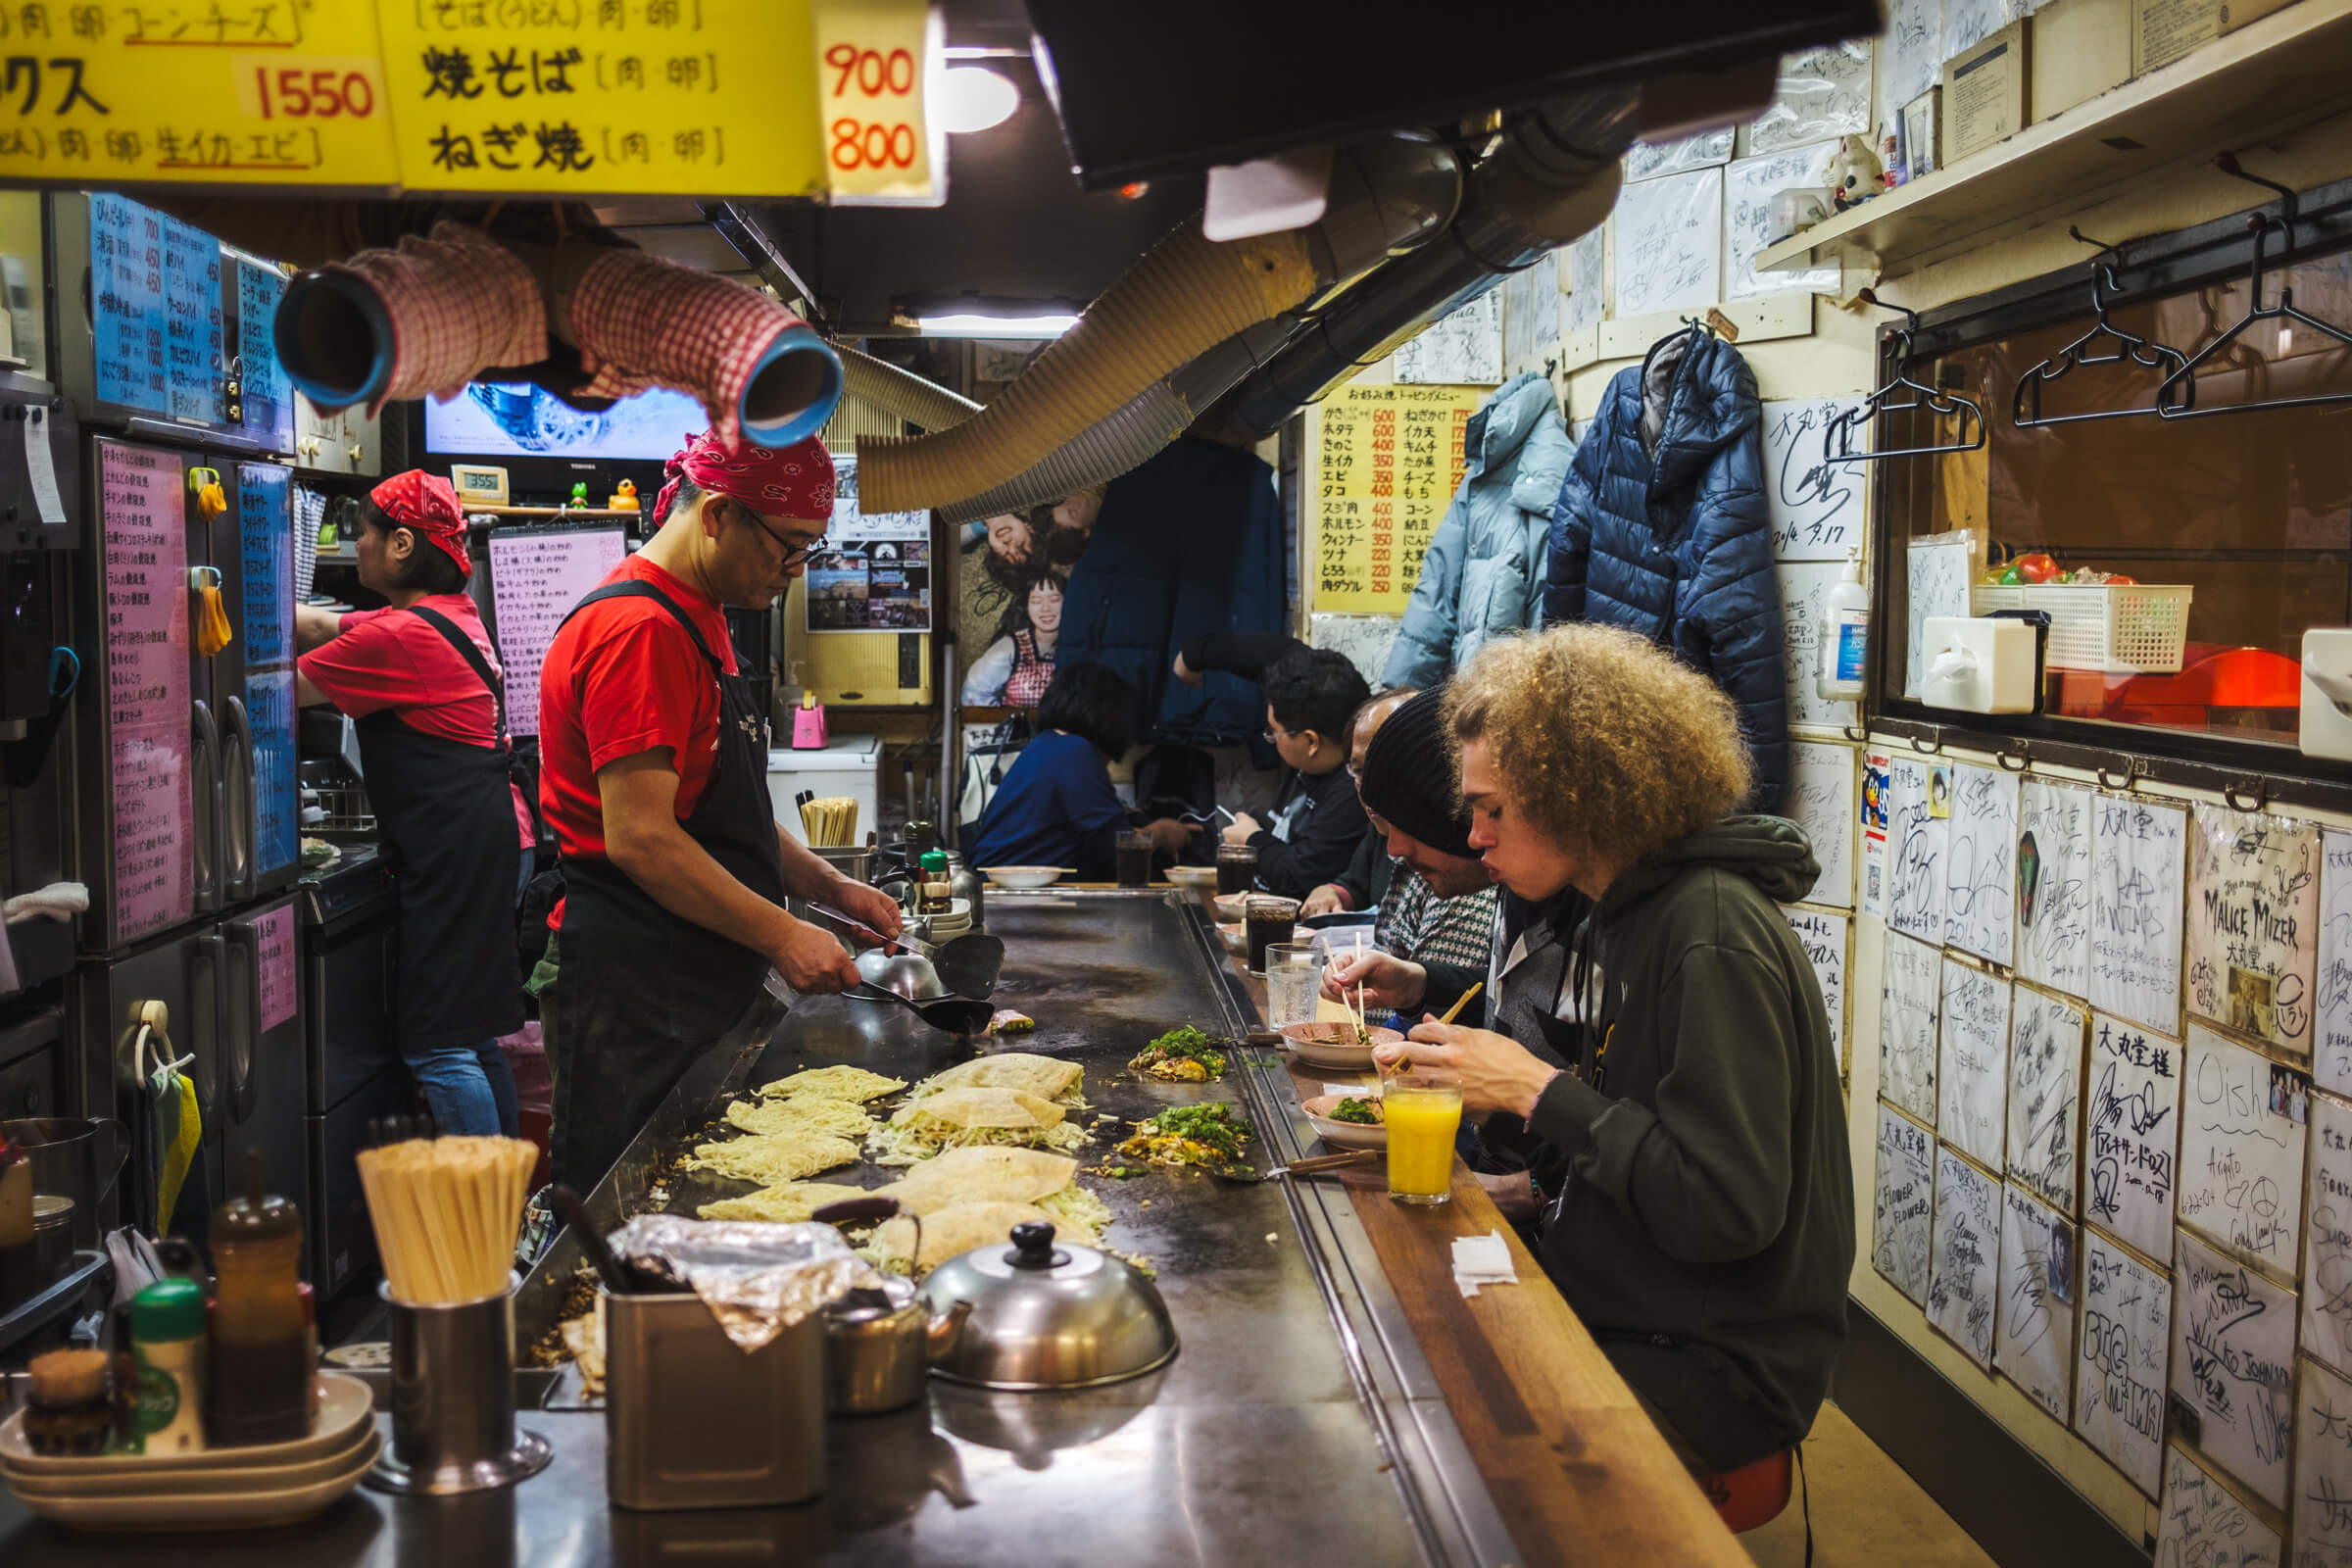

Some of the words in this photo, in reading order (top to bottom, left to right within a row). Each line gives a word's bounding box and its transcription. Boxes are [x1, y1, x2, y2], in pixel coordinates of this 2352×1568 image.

[422, 45, 583, 99] 焼そば
[825, 43, 914, 98] 900
[0, 56, 110, 116] クス
[257, 67, 373, 120] 1550
[429, 122, 595, 172] ねぎ焼
[830, 118, 915, 172] 800
[1348, 389, 1396, 400] お好み焼
[1399, 391, 1460, 401] トッピングメニュー
[1324, 408, 1343, 419] かき
[1373, 409, 1396, 422] 600
[1403, 409, 1446, 421] ねぎかけ
[1324, 422, 1354, 435] ホタテ
[1373, 424, 1396, 437] 600
[1403, 424, 1436, 438] イカ天
[1451, 426, 1466, 439] 17
[1324, 438, 1353, 451] きのこ
[1372, 439, 1395, 452] 400
[1403, 440, 1438, 453] キムチ
[1451, 442, 1465, 455] 17
[1323, 455, 1353, 467] 生イカ
[1372, 454, 1394, 467] 350
[1451, 457, 1465, 470] 17
[1323, 470, 1348, 482] エビ
[1372, 470, 1394, 483] 350
[1403, 471, 1435, 484] チーズ
[1450, 472, 1465, 485] 22
[1323, 485, 1346, 498] タコ
[1370, 484, 1394, 498] 400
[1403, 486, 1429, 499] もち
[1322, 501, 1358, 514] スジ肉
[1372, 503, 1393, 514] 400
[1405, 504, 1434, 514] コーン
[1322, 516, 1364, 530] ホルモン
[1372, 517, 1393, 530] 400
[1404, 518, 1429, 530] 納豆
[1372, 533, 1393, 546] 350
[1322, 549, 1348, 562] ツナ
[1372, 549, 1391, 561] 220
[1321, 564, 1346, 576] とろろ
[1372, 564, 1391, 577] 220
[1321, 579, 1363, 593] 肉ダブル
[1372, 580, 1390, 593] 250
[2205, 889, 2248, 940] MALICE
[2253, 897, 2298, 953] MIZER
[2099, 1024, 2174, 1078] 大丸堂様
[1884, 1183, 1913, 1208] FLOWER
[1893, 1199, 1930, 1226] FLOWER
